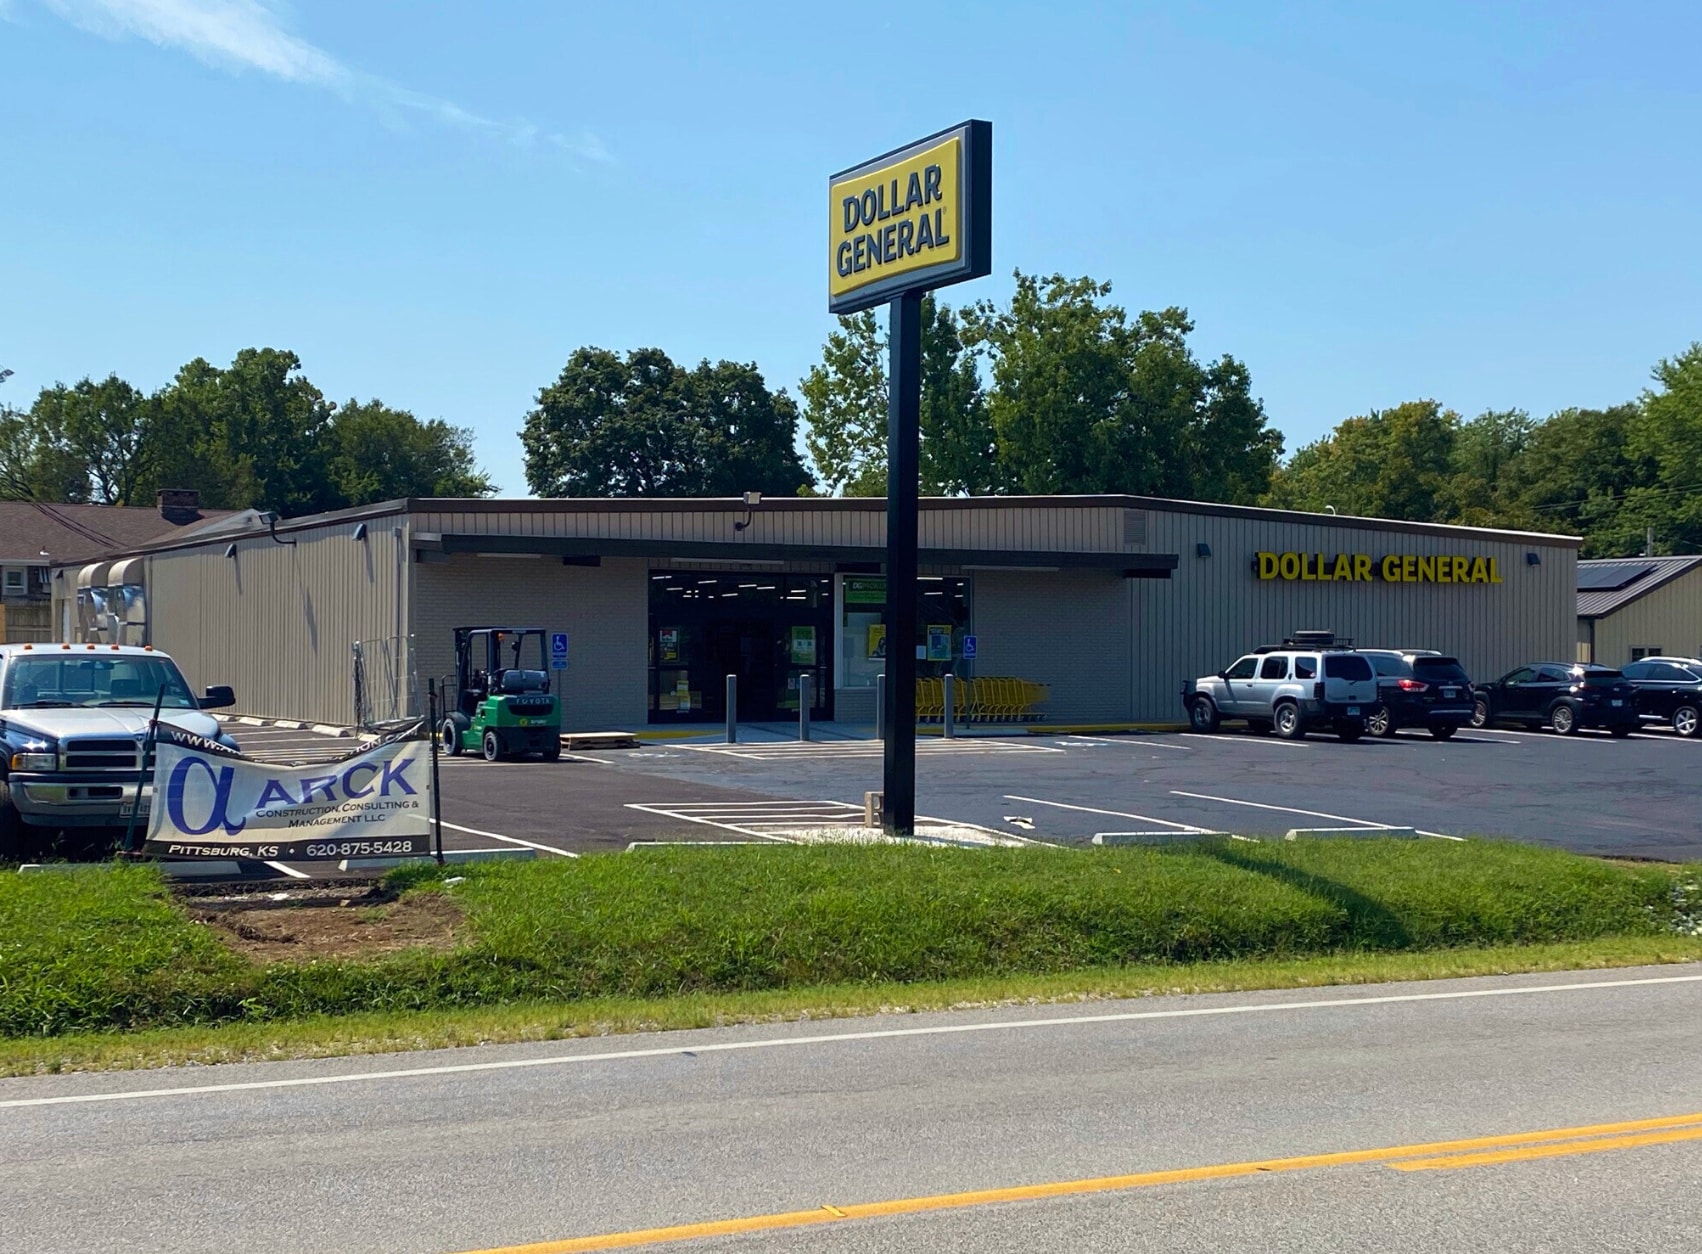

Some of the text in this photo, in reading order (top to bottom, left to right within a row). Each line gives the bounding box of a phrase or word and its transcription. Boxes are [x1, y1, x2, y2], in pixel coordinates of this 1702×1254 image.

[843, 164, 942, 233] DOLLAR
[837, 208, 949, 277] GENERAL
[1257, 552, 1504, 584] DOLLAR GENERAL
[516, 697, 550, 705] TOYOTA
[254, 758, 417, 810] ARCK
[342, 801, 410, 812] CONSULTING
[288, 814, 386, 828] MANAGEMENT LLC
[257, 845, 279, 857] KS
[306, 841, 413, 857] 620-875-5428
